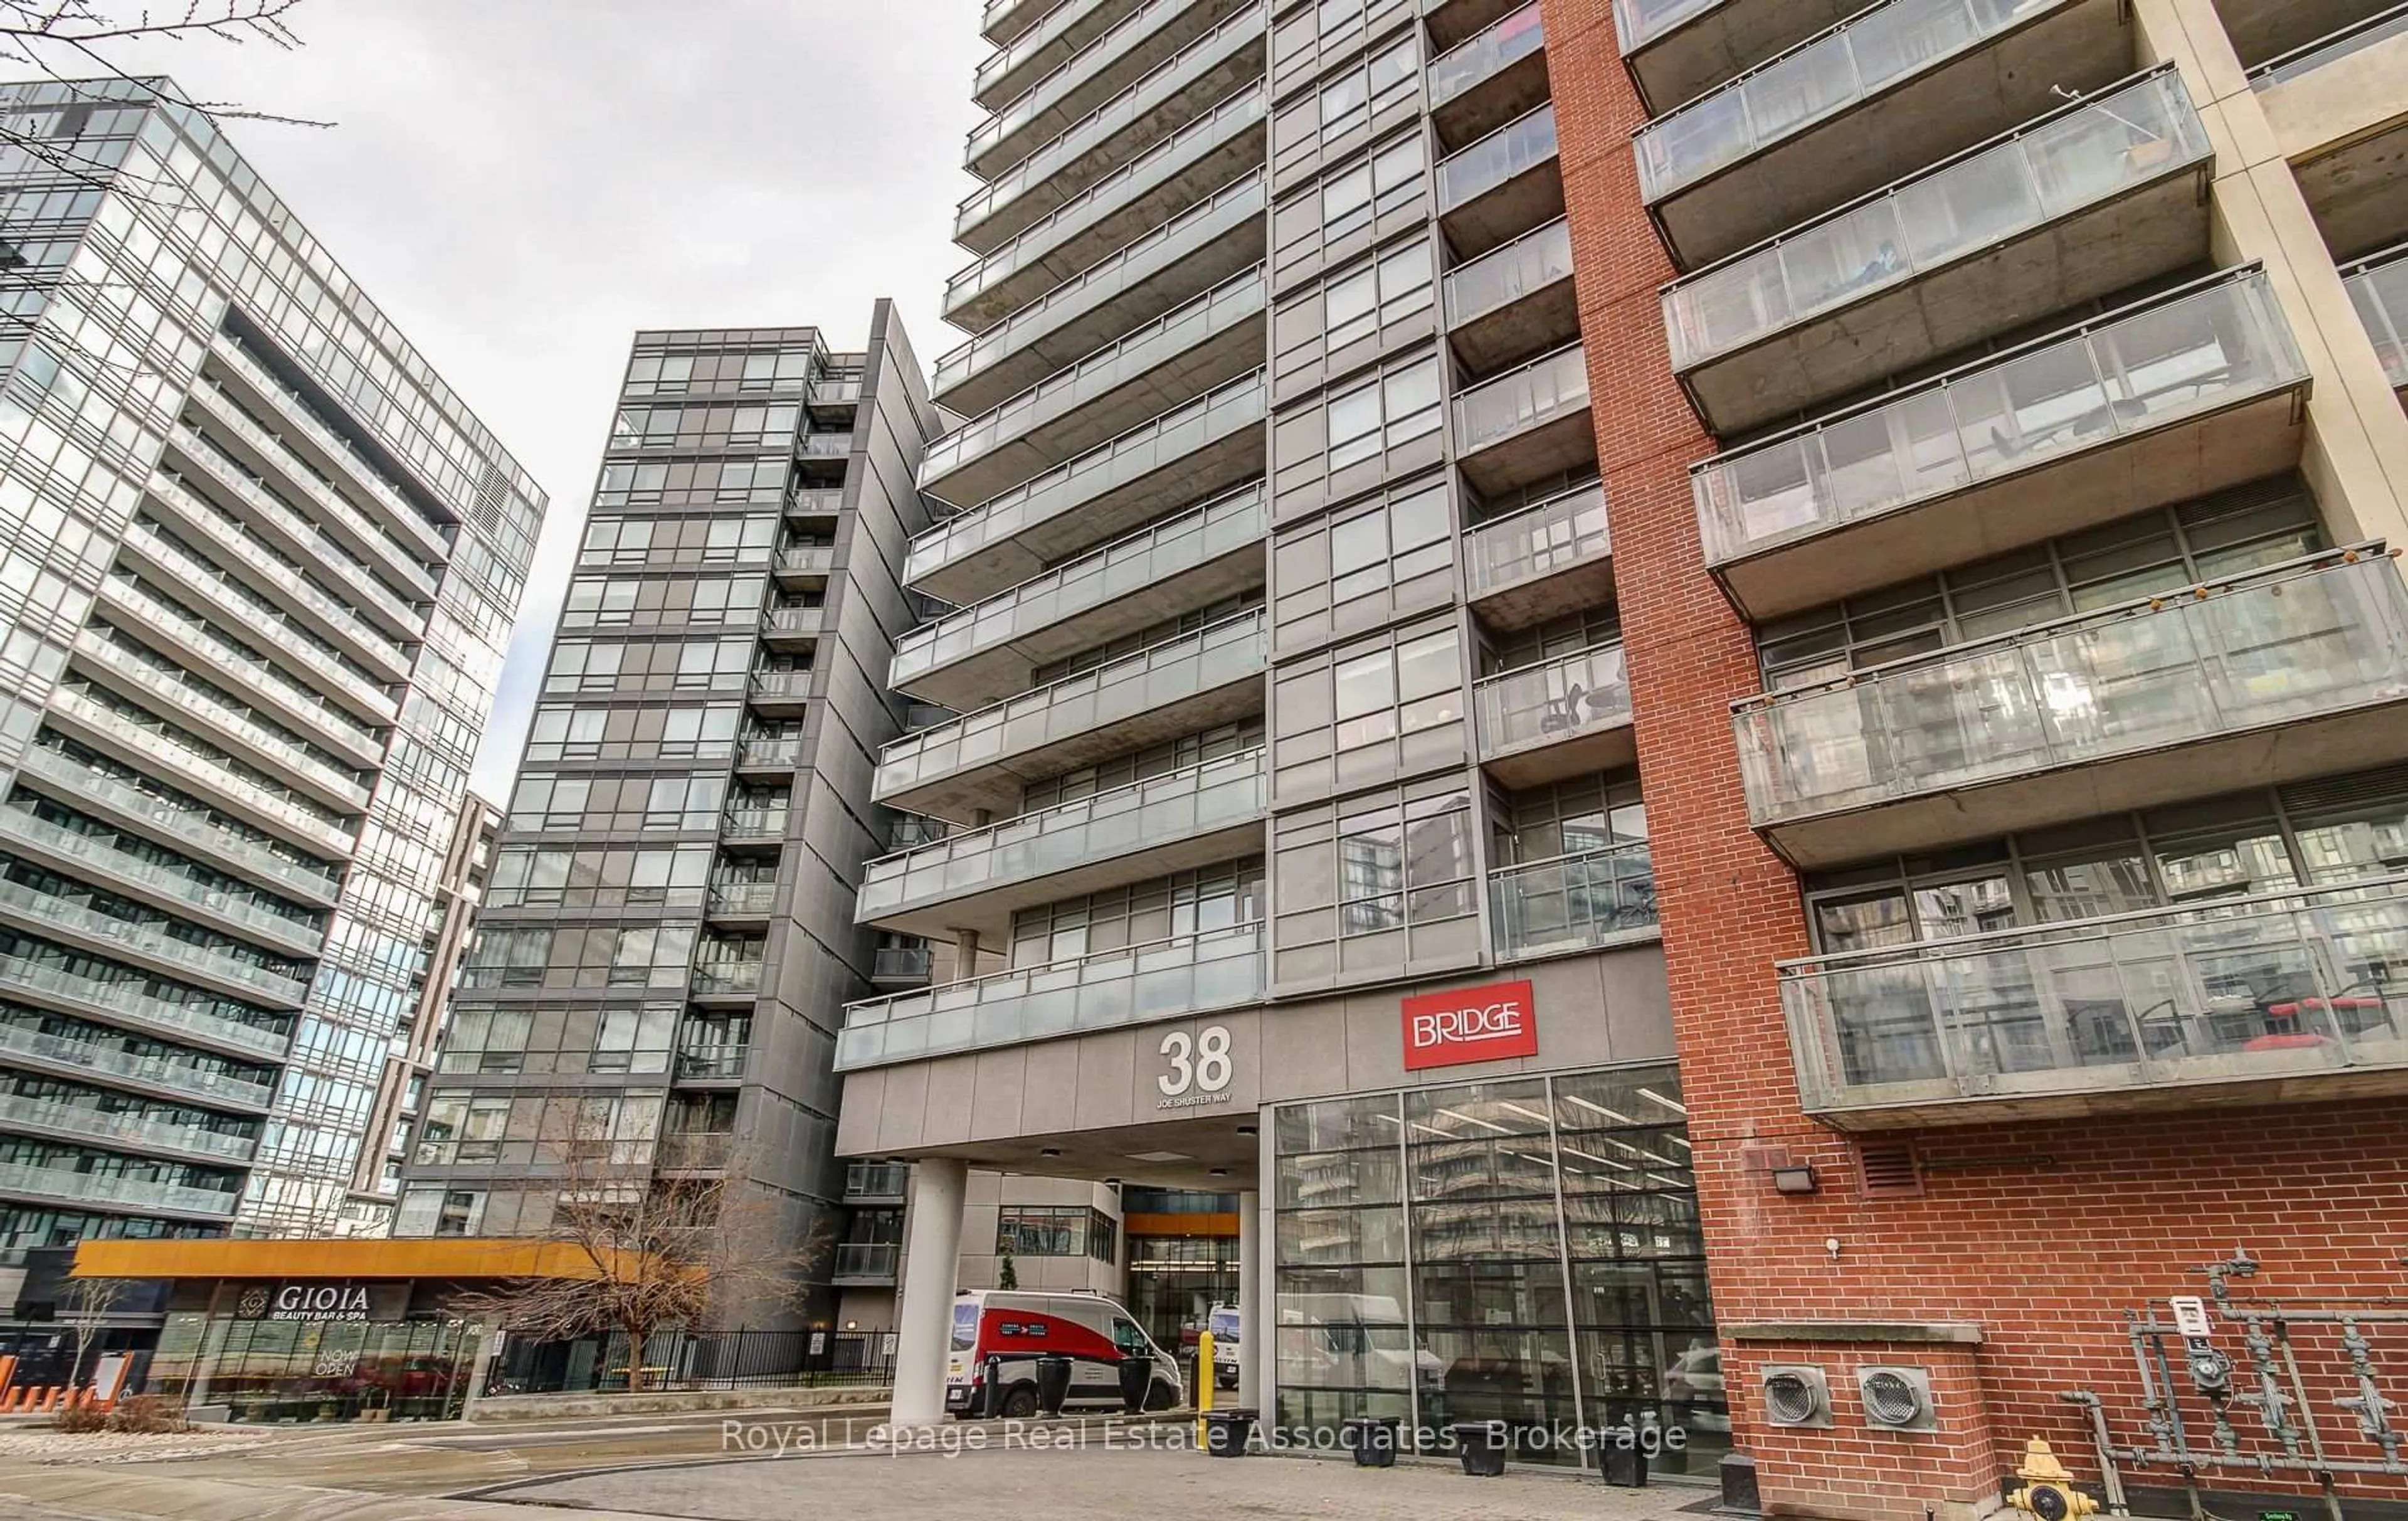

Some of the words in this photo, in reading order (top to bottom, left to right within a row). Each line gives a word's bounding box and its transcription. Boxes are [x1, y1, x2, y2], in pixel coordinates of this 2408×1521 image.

[1413, 1002, 1522, 1047] BRIDGE
[1157, 1025, 1233, 1096] 38
[1157, 1099, 1174, 1108] JOE
[1175, 1095, 1212, 1106] SHUSTER
[1213, 1093, 1230, 1103] WAY
[278, 1286, 369, 1310] GIOIA
[273, 1312, 313, 1320] BEAUTY
[314, 1312, 335, 1320] BAR
[336, 1312, 344, 1320] &
[346, 1312, 366, 1320] SPA
[320, 1350, 358, 1362] NOW
[315, 1363, 355, 1375] OPEN
